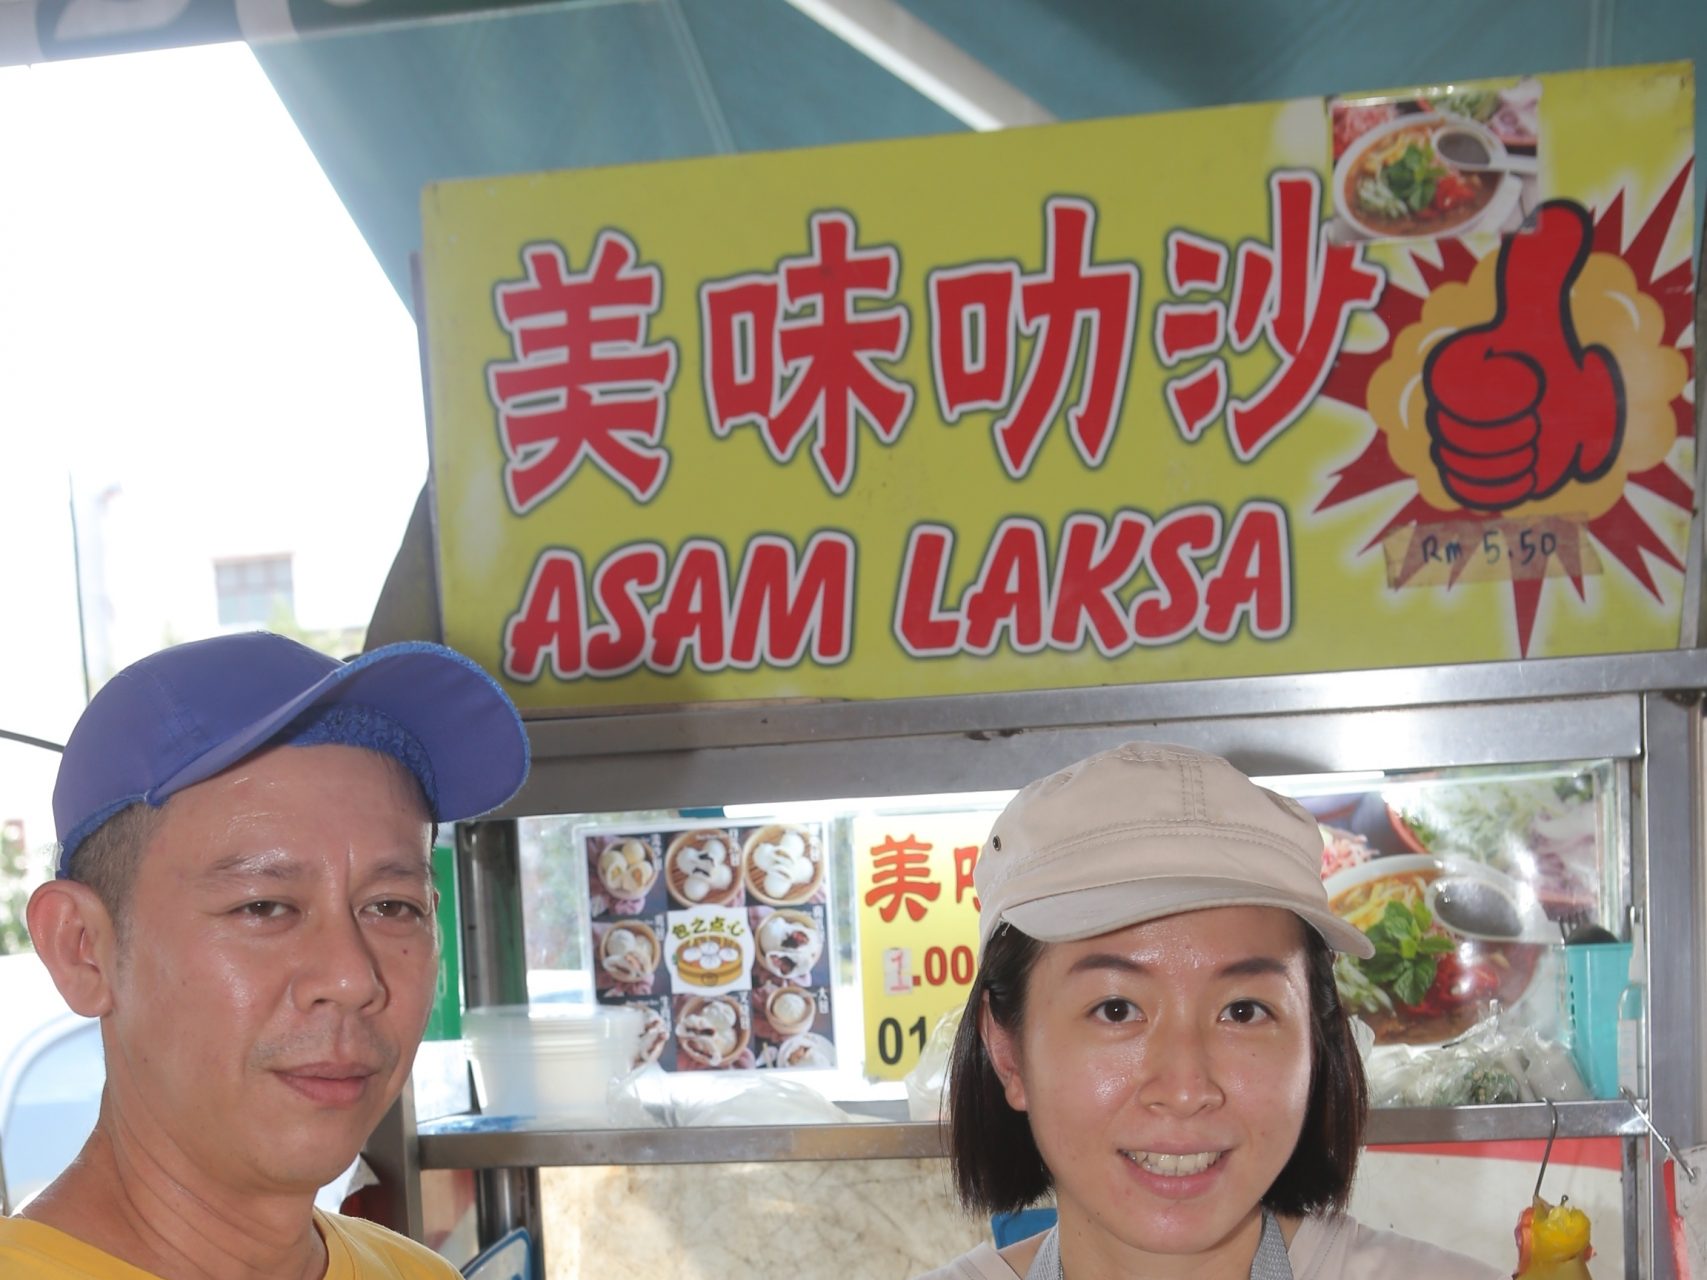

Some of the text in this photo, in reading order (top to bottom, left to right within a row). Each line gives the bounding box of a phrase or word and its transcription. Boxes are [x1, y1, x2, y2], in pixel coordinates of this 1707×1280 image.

[485, 169, 1385, 518] 美味叻沙
[1483, 529, 1557, 566] 5.50
[503, 500, 1293, 682] ASAM LAKSA
[672, 916, 745, 939] 包之点心
[888, 945, 975, 992] 1.00
